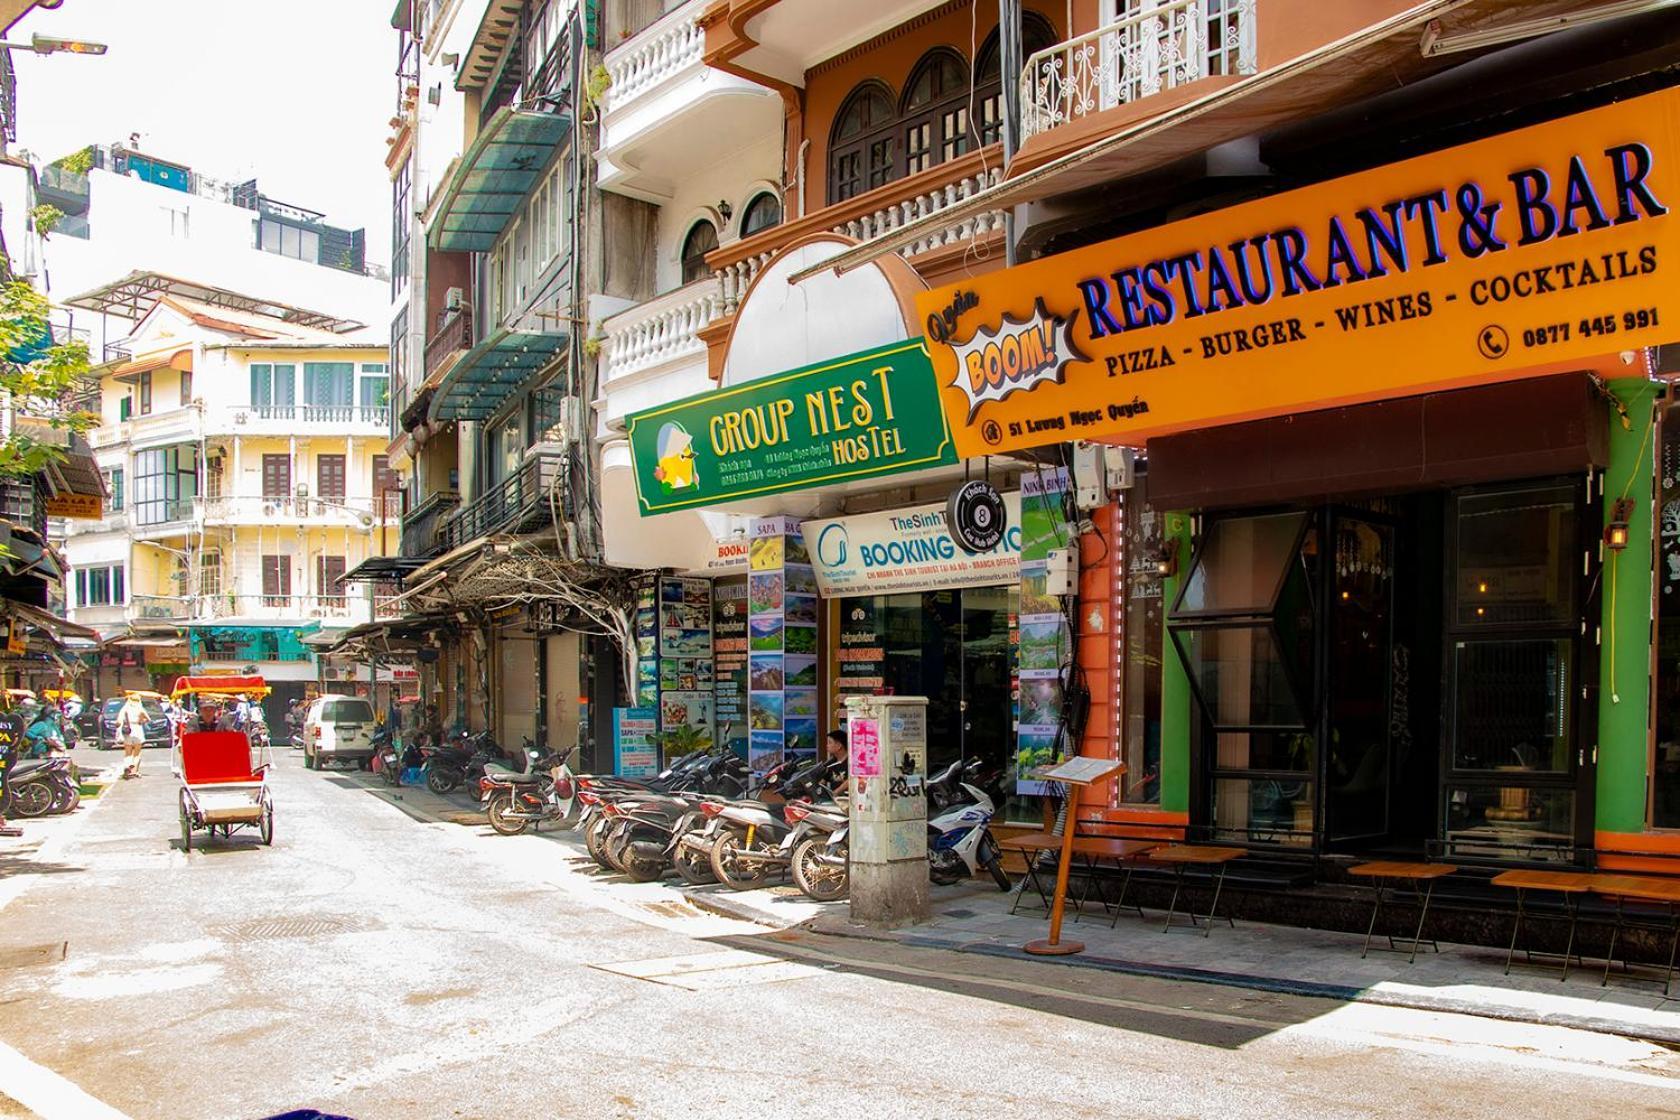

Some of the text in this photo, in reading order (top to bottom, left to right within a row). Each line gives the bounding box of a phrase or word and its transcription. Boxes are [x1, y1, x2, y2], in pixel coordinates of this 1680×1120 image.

[1077, 187, 1449, 340] RESTAURANT
[1106, 345, 1175, 377] PIZZA
[1200, 317, 1307, 358] BURGER
[1335, 291, 1433, 331] WINES
[1470, 246, 1657, 306] COCKTAILS
[1523, 307, 1659, 348] 0877 445 991
[965, 319, 1057, 396] BOOM!
[709, 365, 895, 457] GROUP NEST
[1009, 423, 1023, 436] 51
[833, 427, 906, 466] HOSTEL
[757, 523, 776, 535] SAPA
[889, 509, 948, 531] TheSinhT
[979, 508, 987, 523] 8
[860, 535, 954, 567] BOOKING
